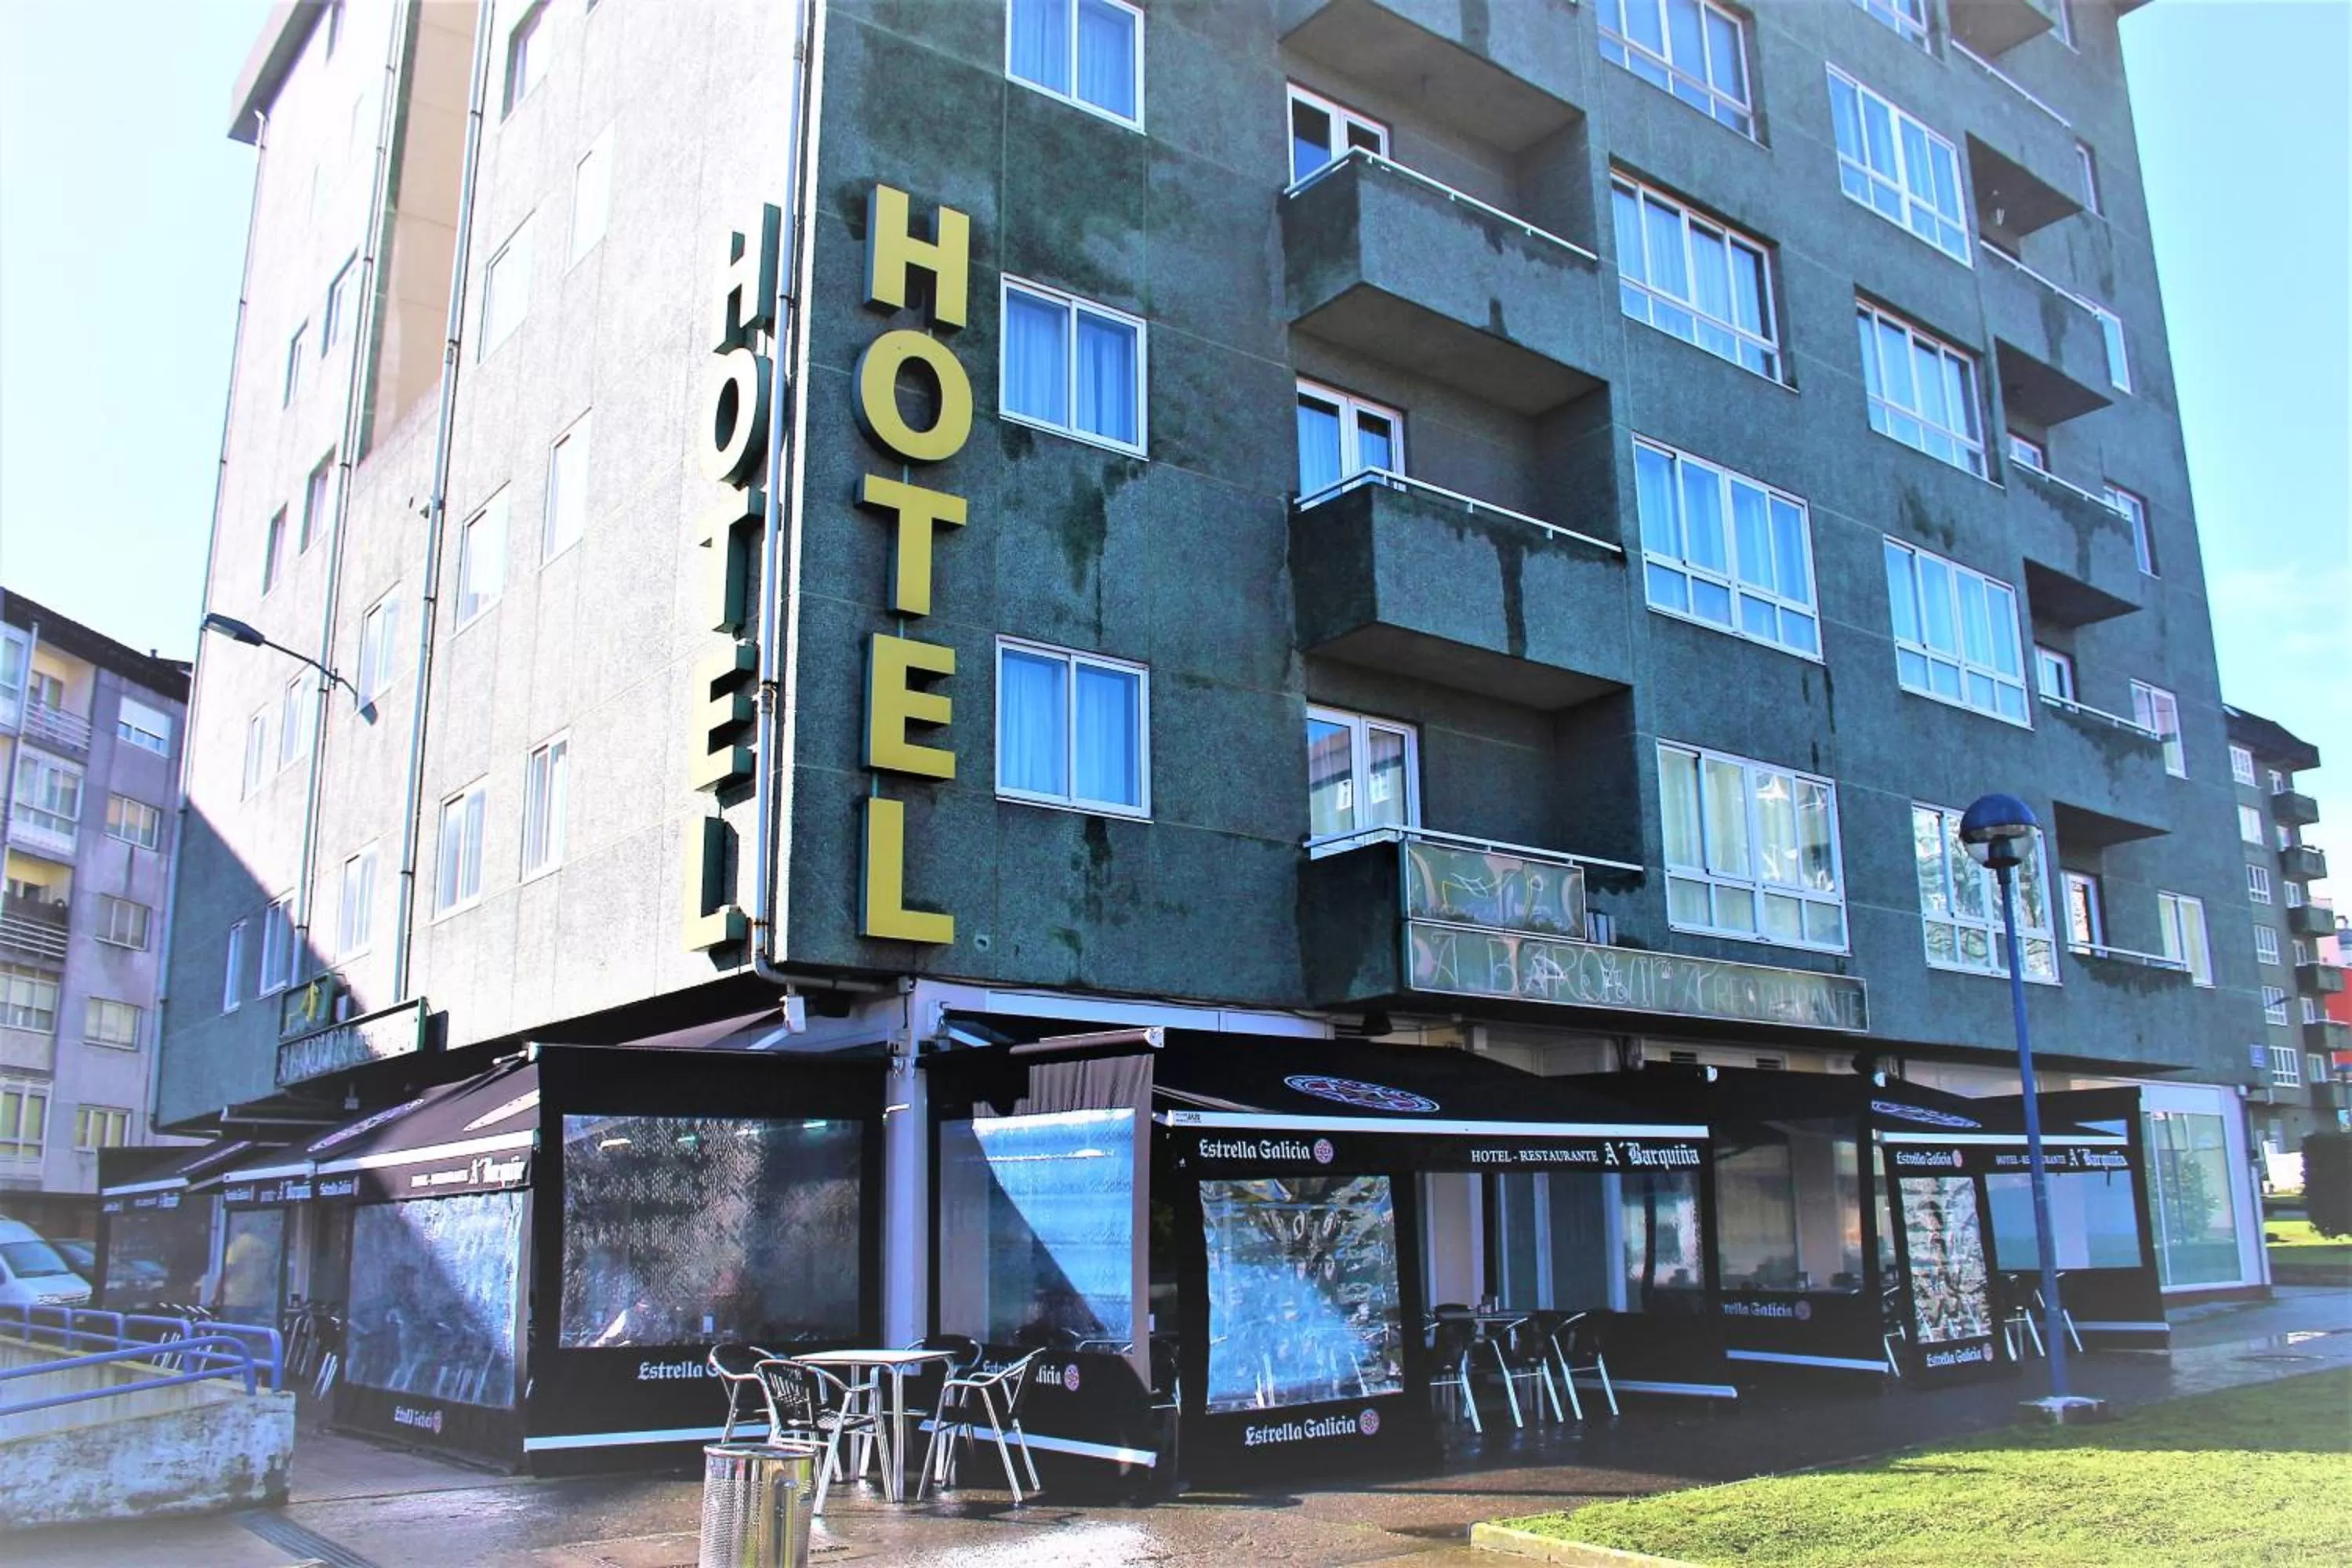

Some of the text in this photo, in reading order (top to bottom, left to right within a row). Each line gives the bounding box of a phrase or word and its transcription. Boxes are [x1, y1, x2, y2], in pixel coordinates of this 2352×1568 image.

[681, 201, 776, 953] HOTEL
[864, 183, 973, 946] HOTEL
[1199, 1138, 1311, 1160] Estrella Galicia
[1471, 1149, 1512, 1163] HOTEL
[1519, 1149, 1599, 1162] RESTAURANTE
[1626, 1142, 1700, 1170] Barquiña
[637, 1361, 703, 1380] Estrella
[1244, 1415, 1357, 1446] Estrella Galicia
